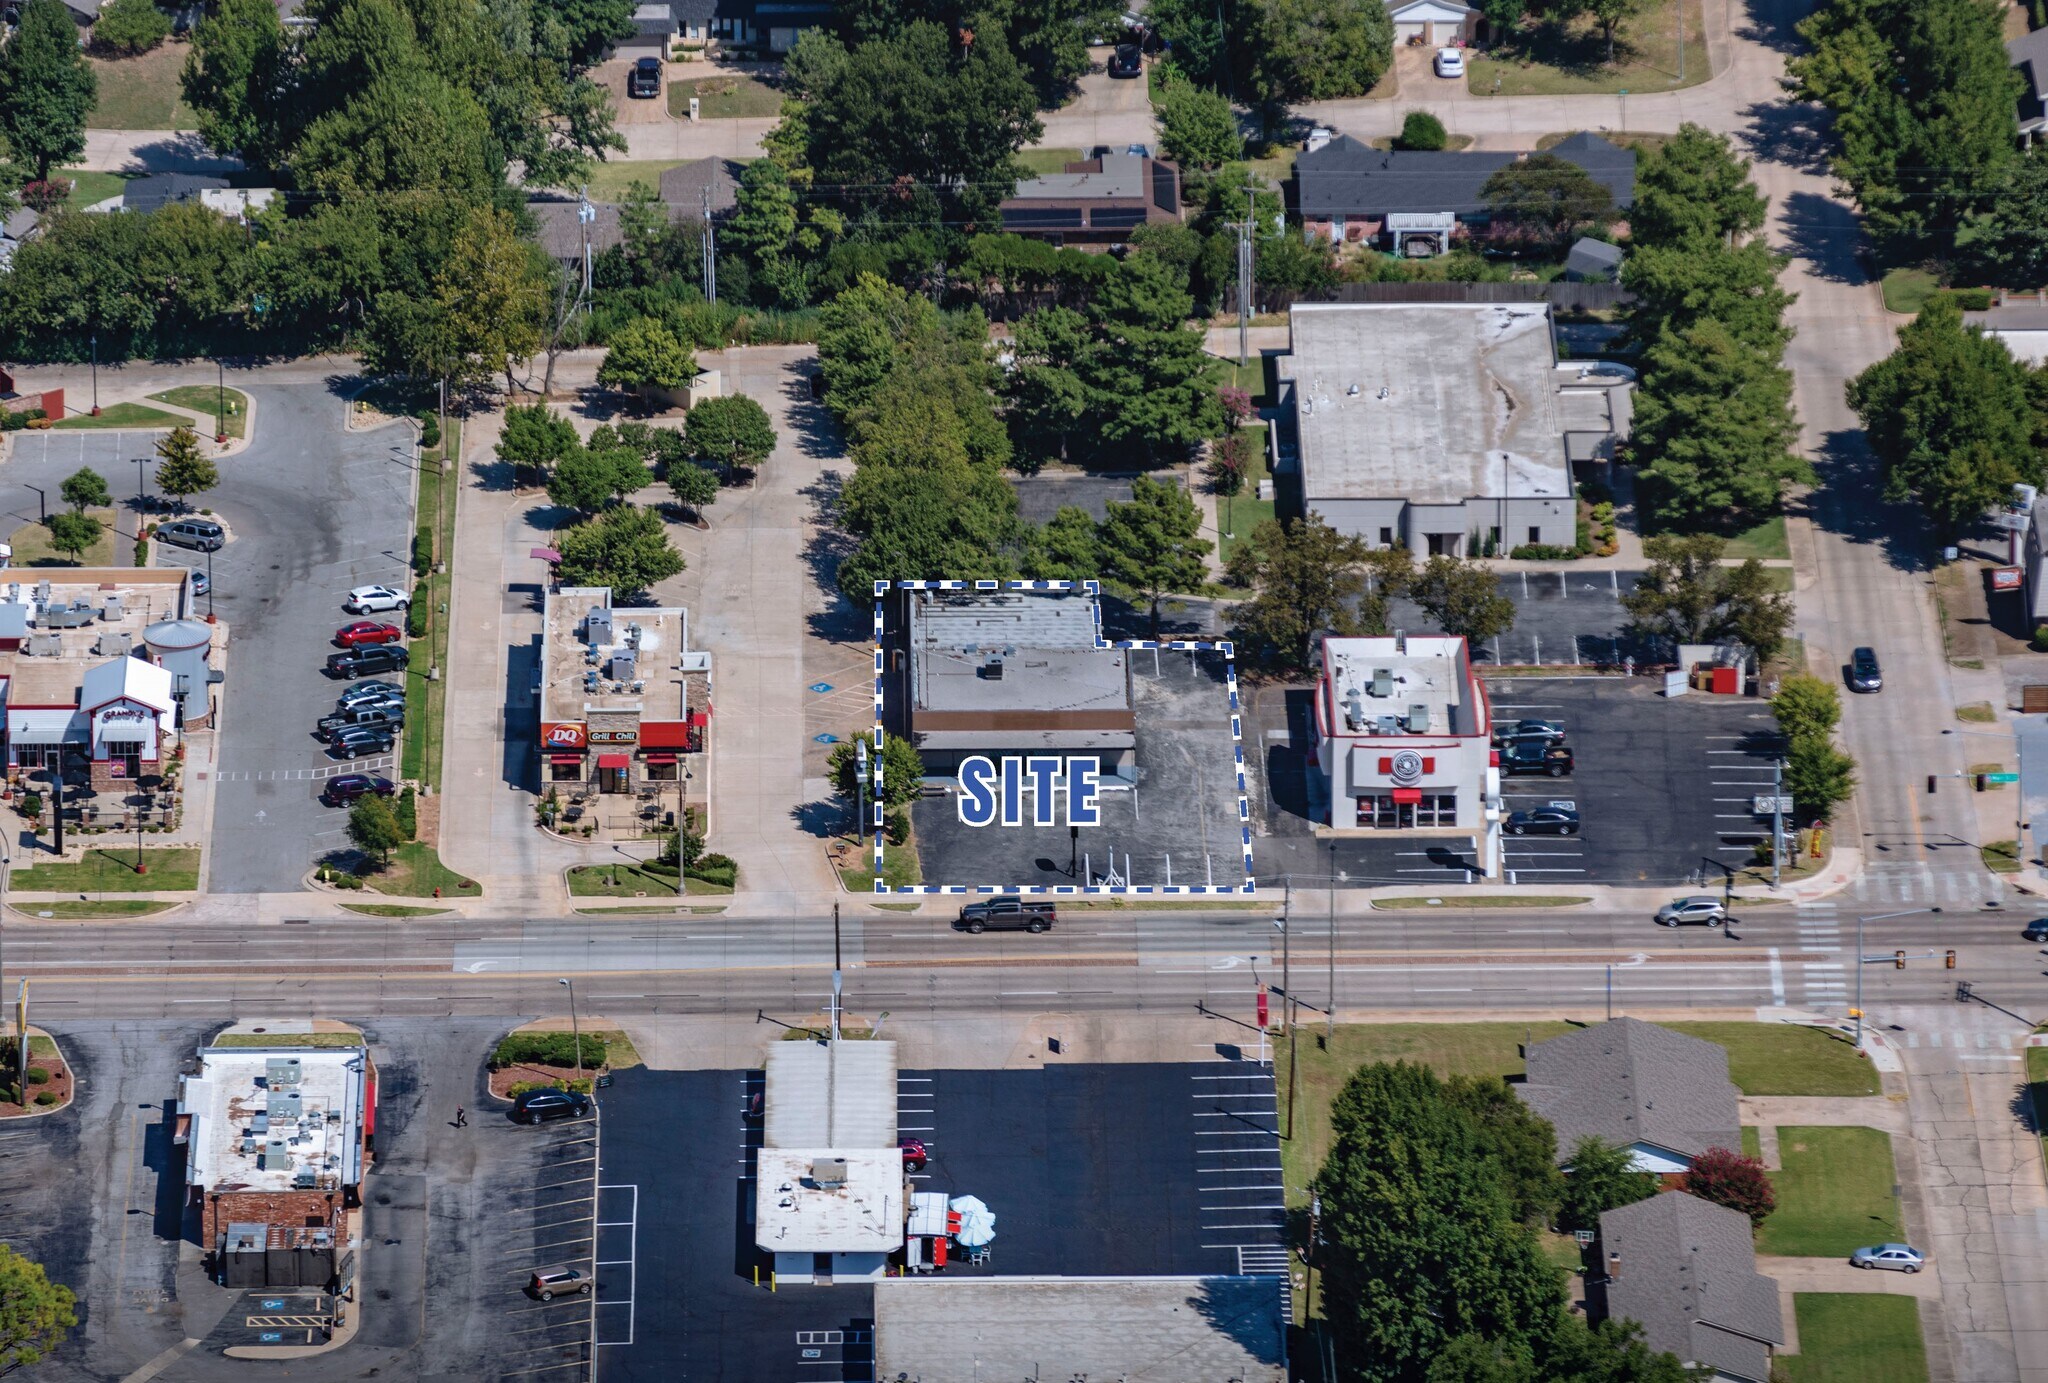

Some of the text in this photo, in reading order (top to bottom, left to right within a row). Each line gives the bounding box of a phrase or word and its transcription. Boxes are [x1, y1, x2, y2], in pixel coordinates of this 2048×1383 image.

[553, 730, 576, 743] DQ
[591, 732, 610, 740] Grill
[615, 732, 635, 740] Chill
